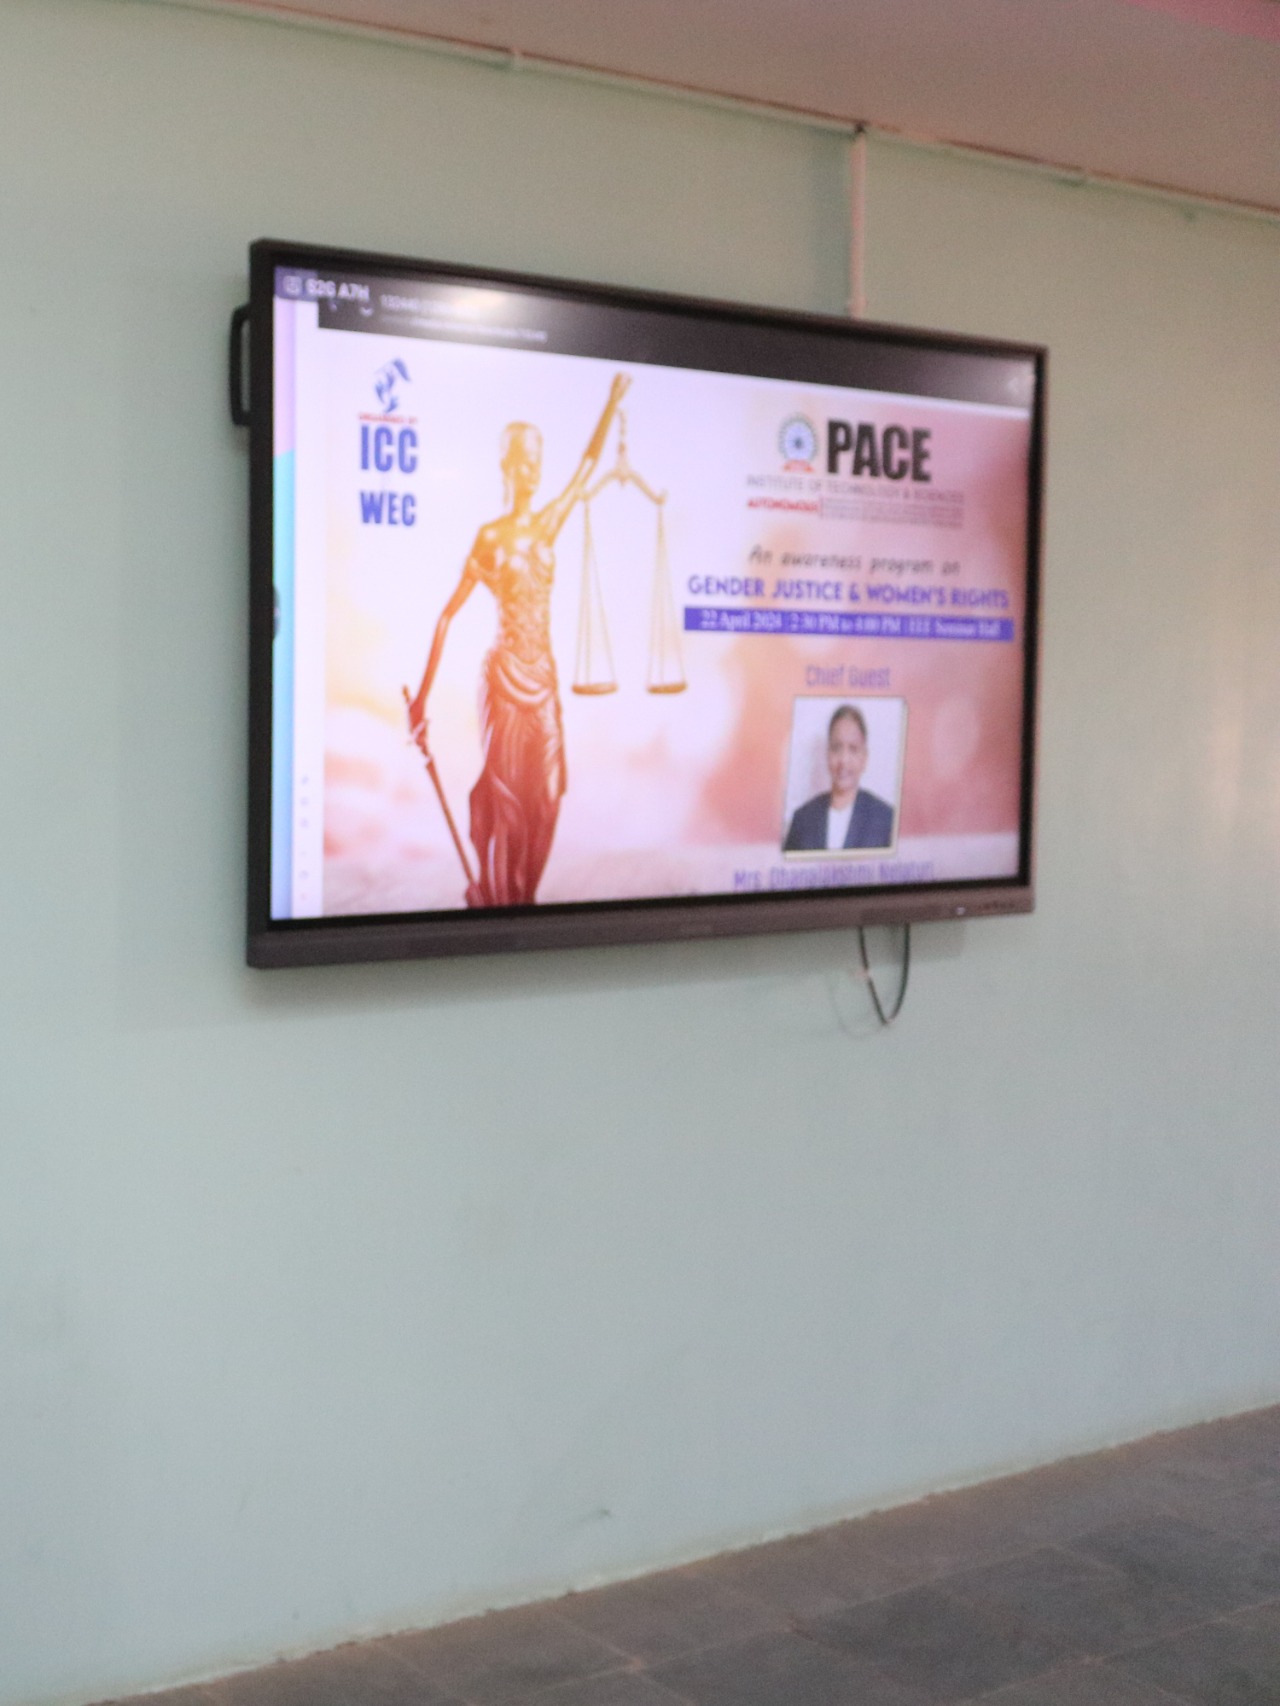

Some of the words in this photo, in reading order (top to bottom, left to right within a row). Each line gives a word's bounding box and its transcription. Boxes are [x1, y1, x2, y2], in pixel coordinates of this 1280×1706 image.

[360, 425, 418, 474] ICC
[827, 420, 932, 482] PACE
[360, 490, 416, 527] WEC
[748, 544, 773, 565] An
[781, 550, 863, 570] awareness
[869, 555, 934, 577] program
[940, 559, 961, 576] on
[688, 574, 765, 598] GENDER
[771, 578, 842, 602] JUSTICE
[848, 582, 860, 602] &
[865, 583, 946, 607] WOMEN'S
[951, 587, 1009, 610] RIGHTS
[700, 609, 718, 630] 22
[720, 610, 752, 632] April
[753, 610, 783, 631] 2024
[818, 612, 840, 633] PM
[806, 663, 844, 687] Chief
[848, 666, 891, 688] Guest
